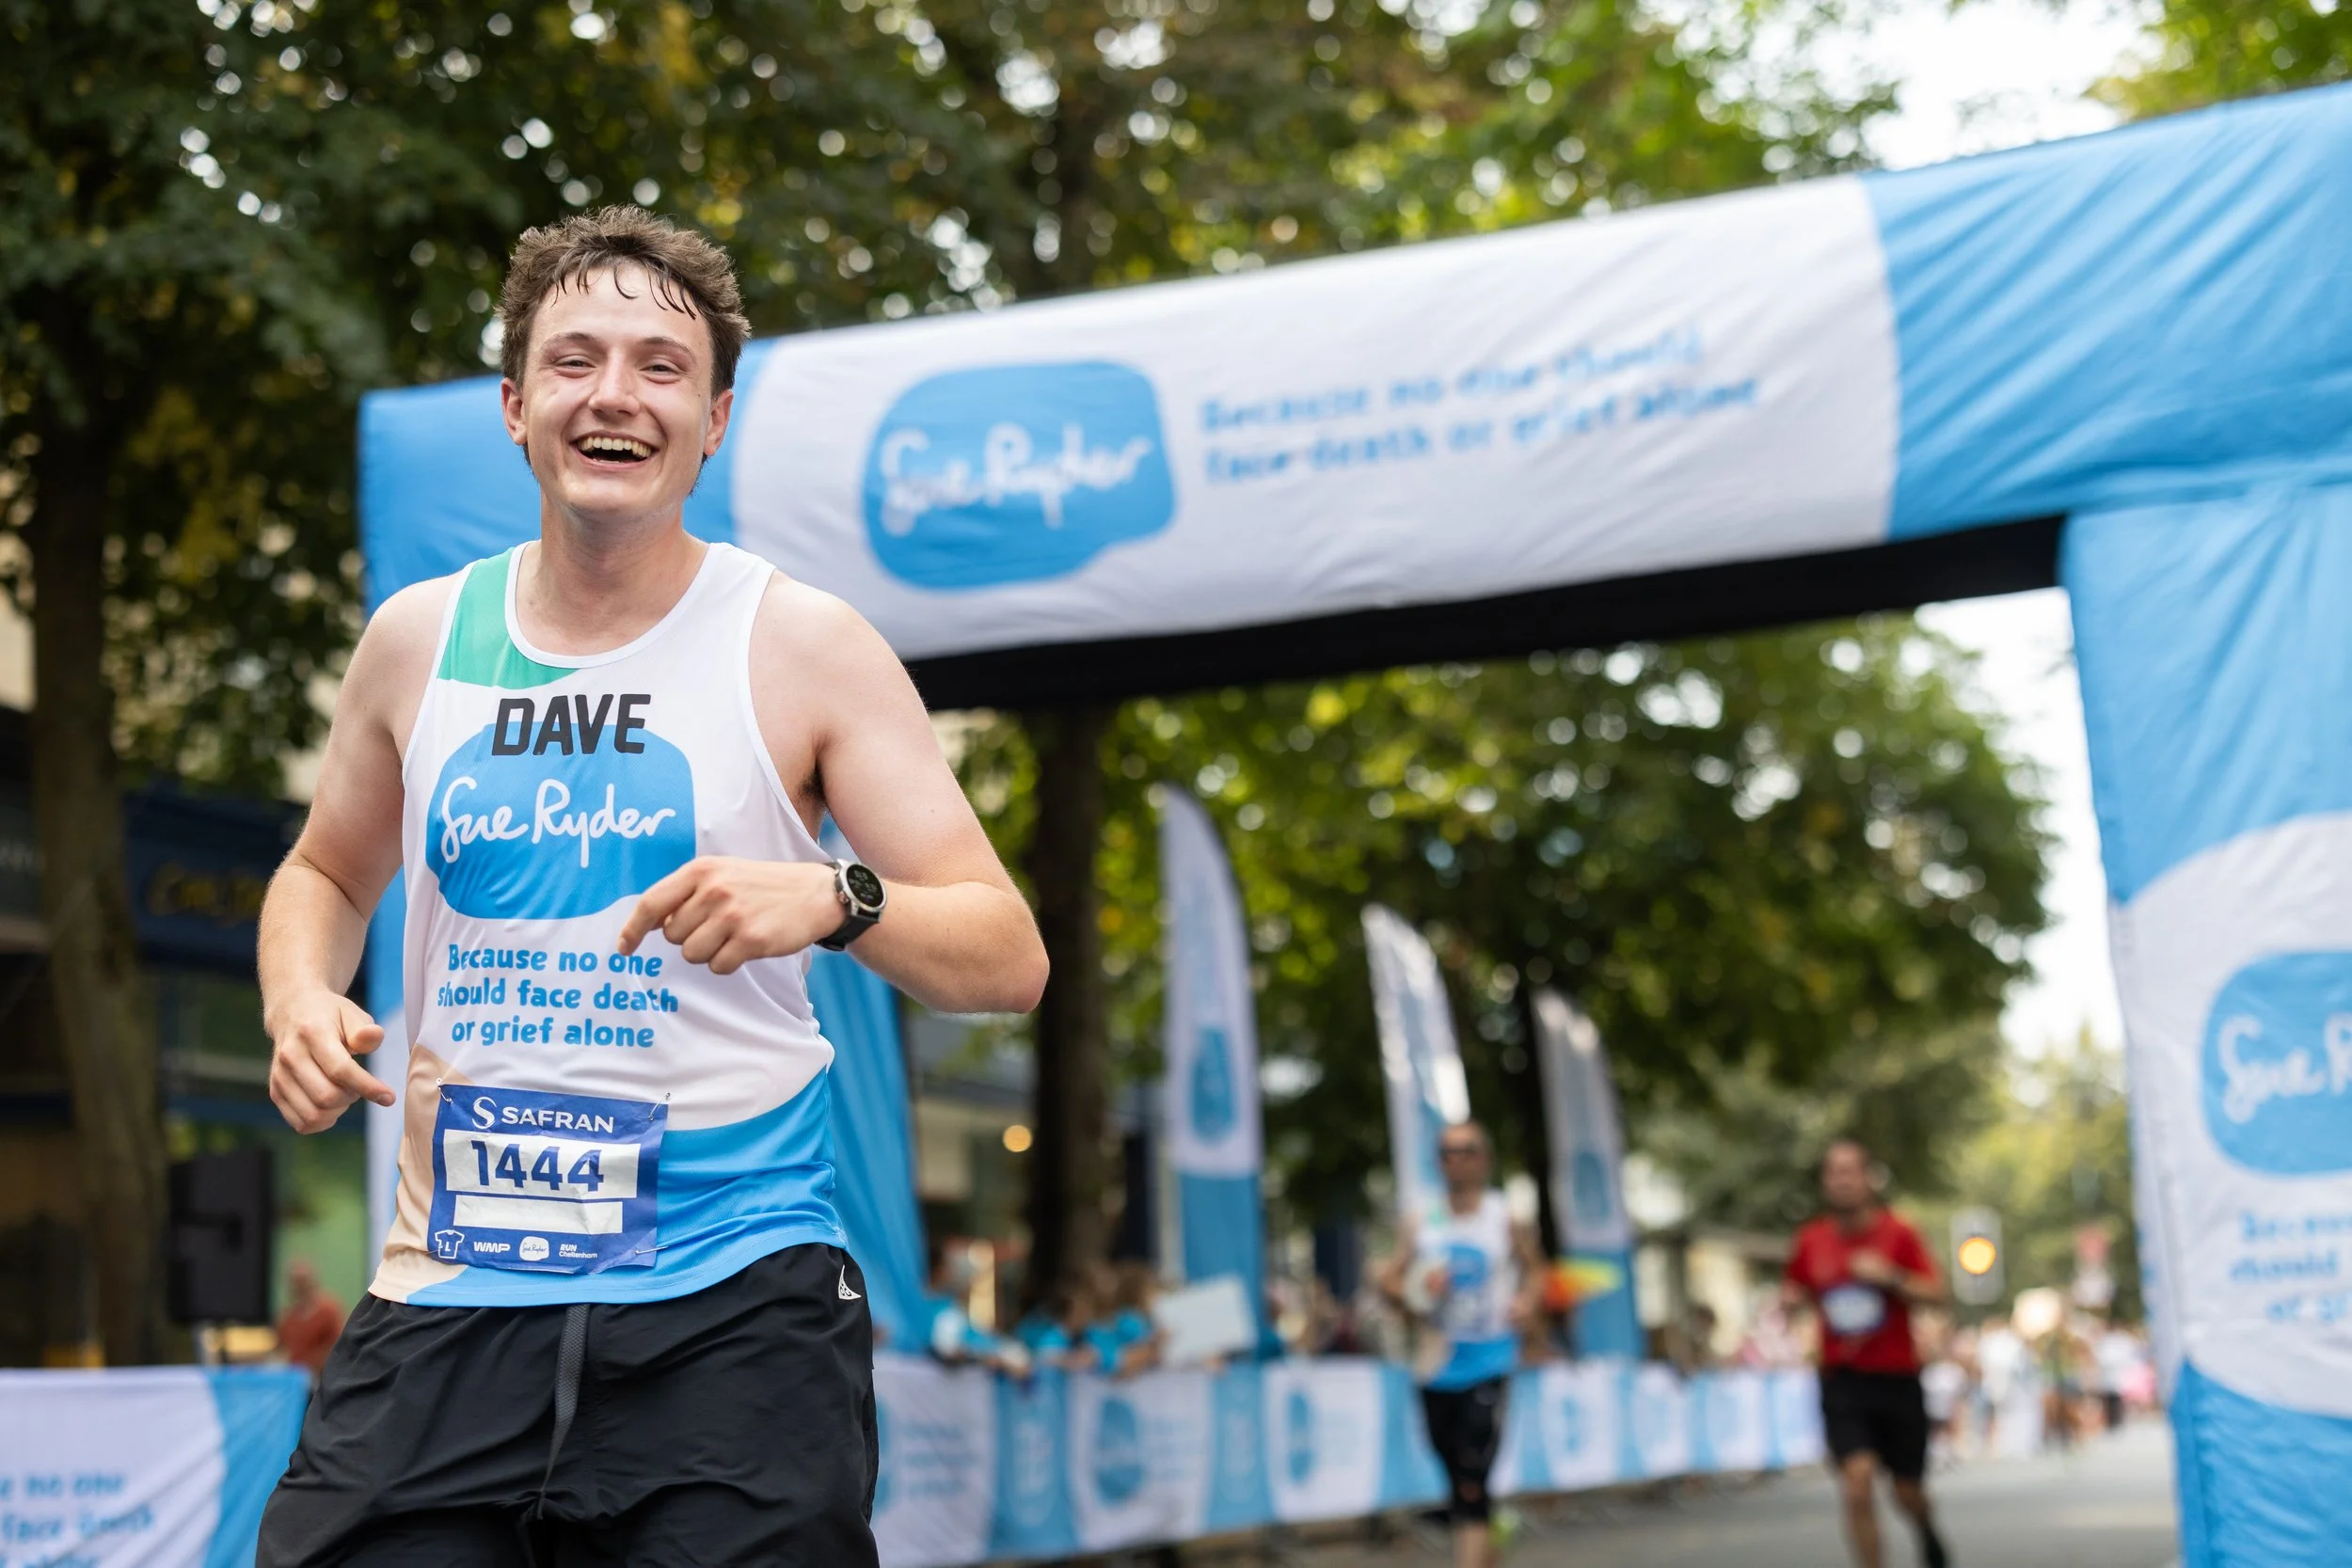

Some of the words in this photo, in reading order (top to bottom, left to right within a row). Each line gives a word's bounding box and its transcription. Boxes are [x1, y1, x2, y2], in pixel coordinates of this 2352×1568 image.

[880, 427, 982, 536] Sue
[491, 693, 651, 756] DAVE
[440, 776, 529, 863] Sue
[531, 778, 676, 868] Ryder
[448, 943, 548, 972] Because
[558, 951, 598, 973] no
[608, 951, 663, 977] one
[437, 977, 506, 1007] should
[517, 979, 582, 1009] face
[593, 982, 679, 1013] death
[452, 1018, 475, 1042] or
[480, 1015, 554, 1047] grief
[564, 1018, 655, 1048] alone
[501, 1106, 614, 1133] SAFRAN
[470, 1140, 605, 1192] 1444
[473, 1241, 511, 1253] WMP
[560, 1243, 578, 1252] RUN
